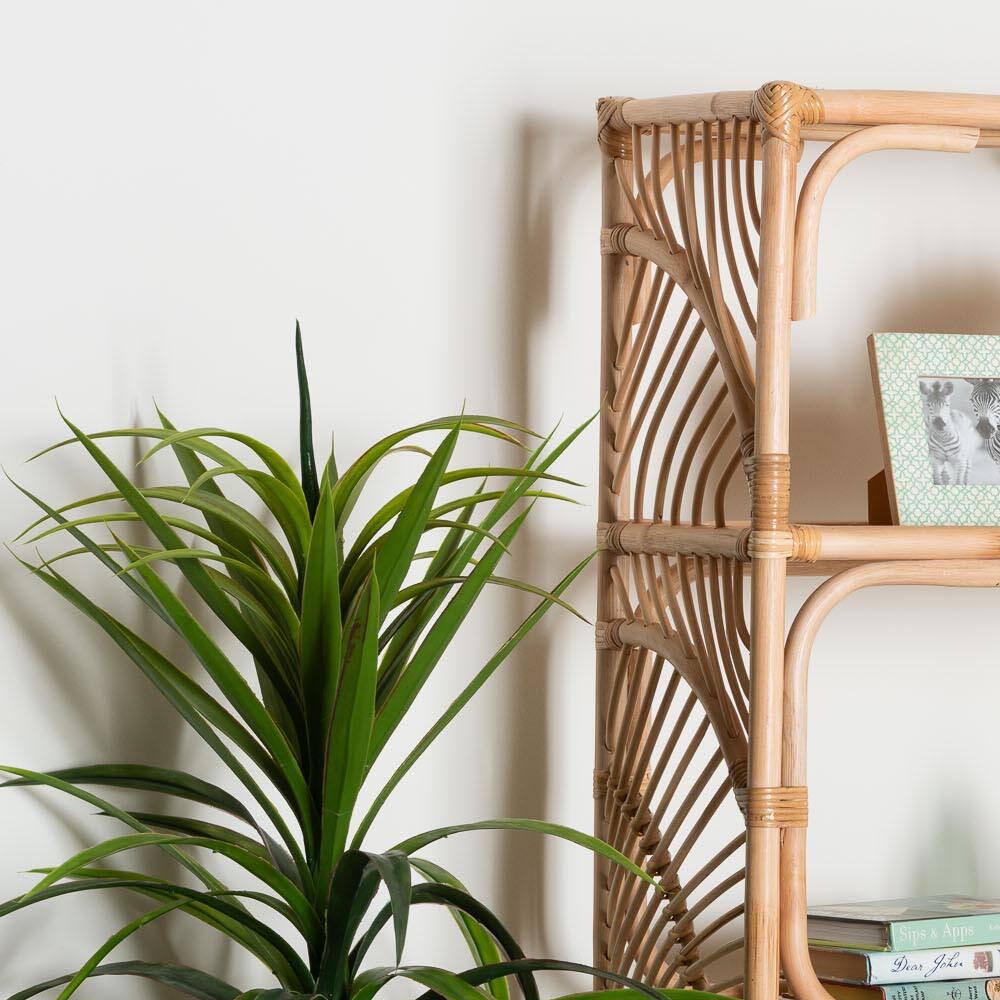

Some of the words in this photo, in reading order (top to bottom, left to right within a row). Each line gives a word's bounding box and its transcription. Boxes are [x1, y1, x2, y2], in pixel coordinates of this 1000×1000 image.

[899, 926, 927, 946] Sips
[930, 928, 938, 939] &
[943, 922, 975, 942] Apps
[891, 955, 923, 973] Dear
[924, 952, 963, 978] John
